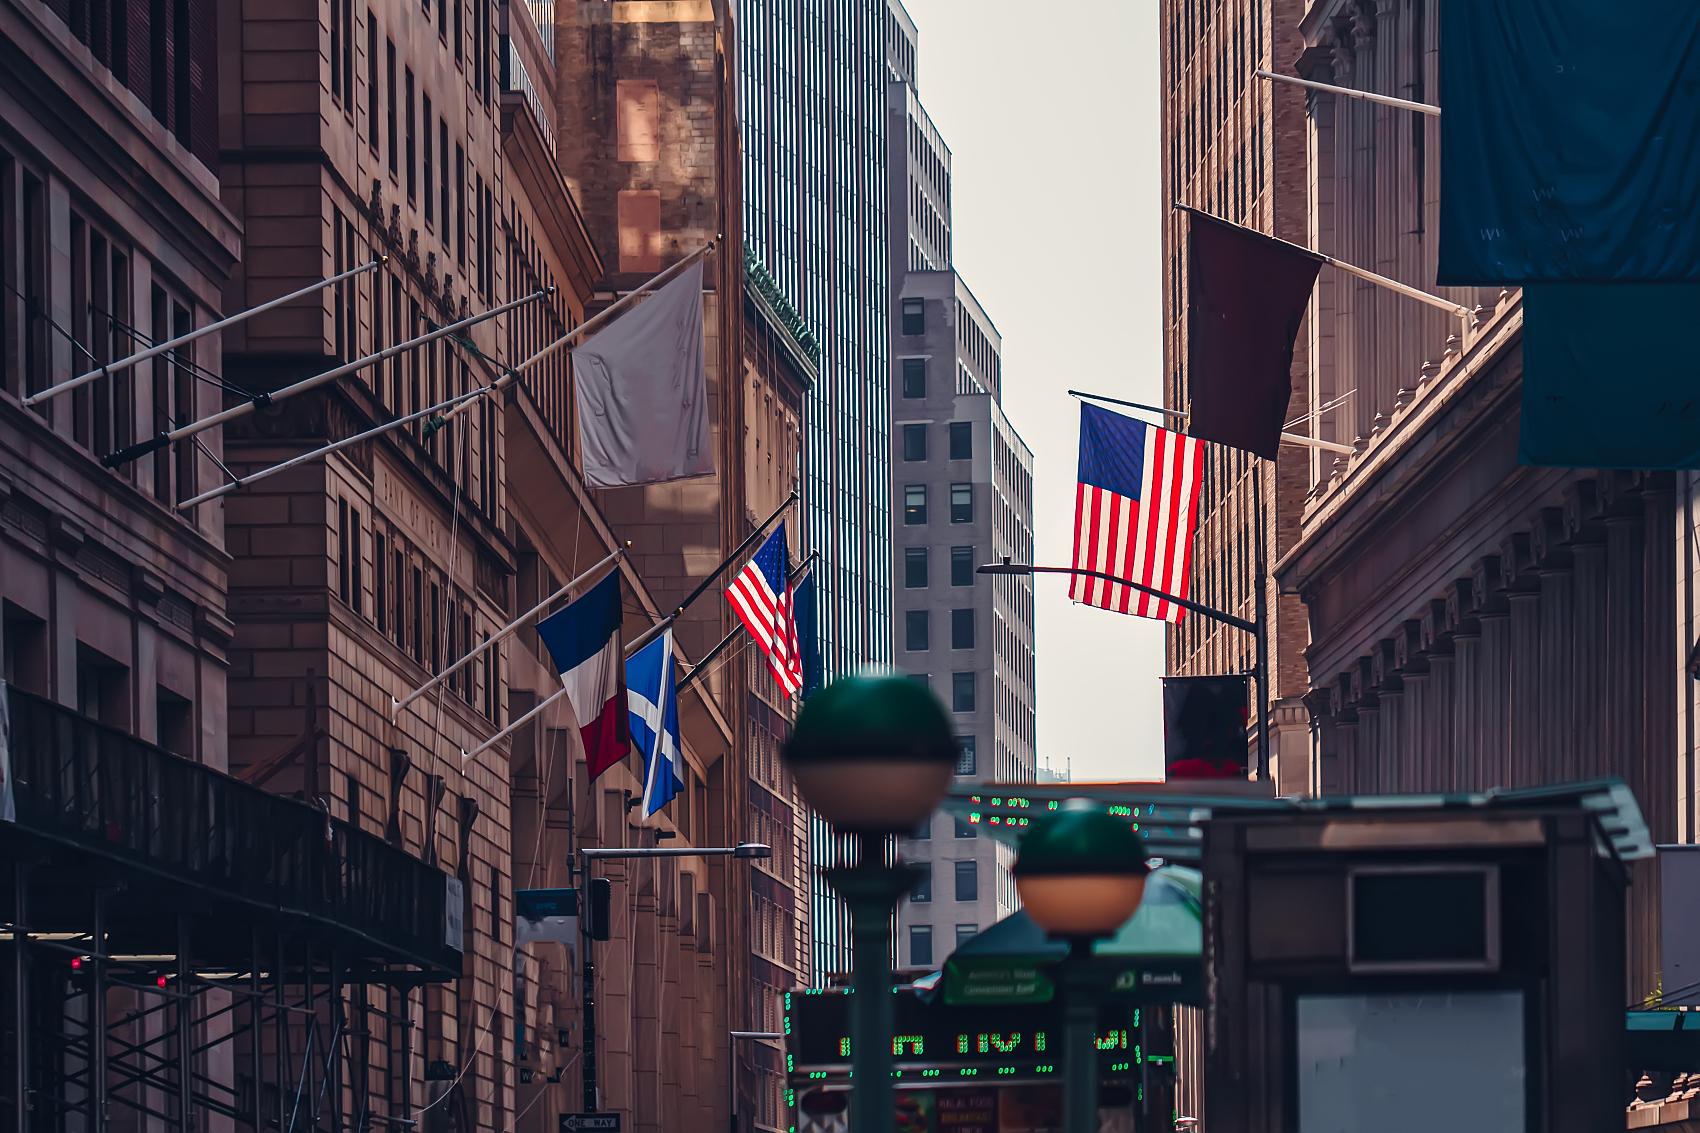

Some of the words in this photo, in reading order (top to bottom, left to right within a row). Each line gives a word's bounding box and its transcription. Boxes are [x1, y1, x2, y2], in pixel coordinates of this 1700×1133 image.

[384, 472, 404, 517] BANK
[410, 498, 419, 531] OF
[1142, 970, 1182, 985] Bank
[568, 1119, 586, 1128] ONE
[593, 1119, 612, 1127] WAY
